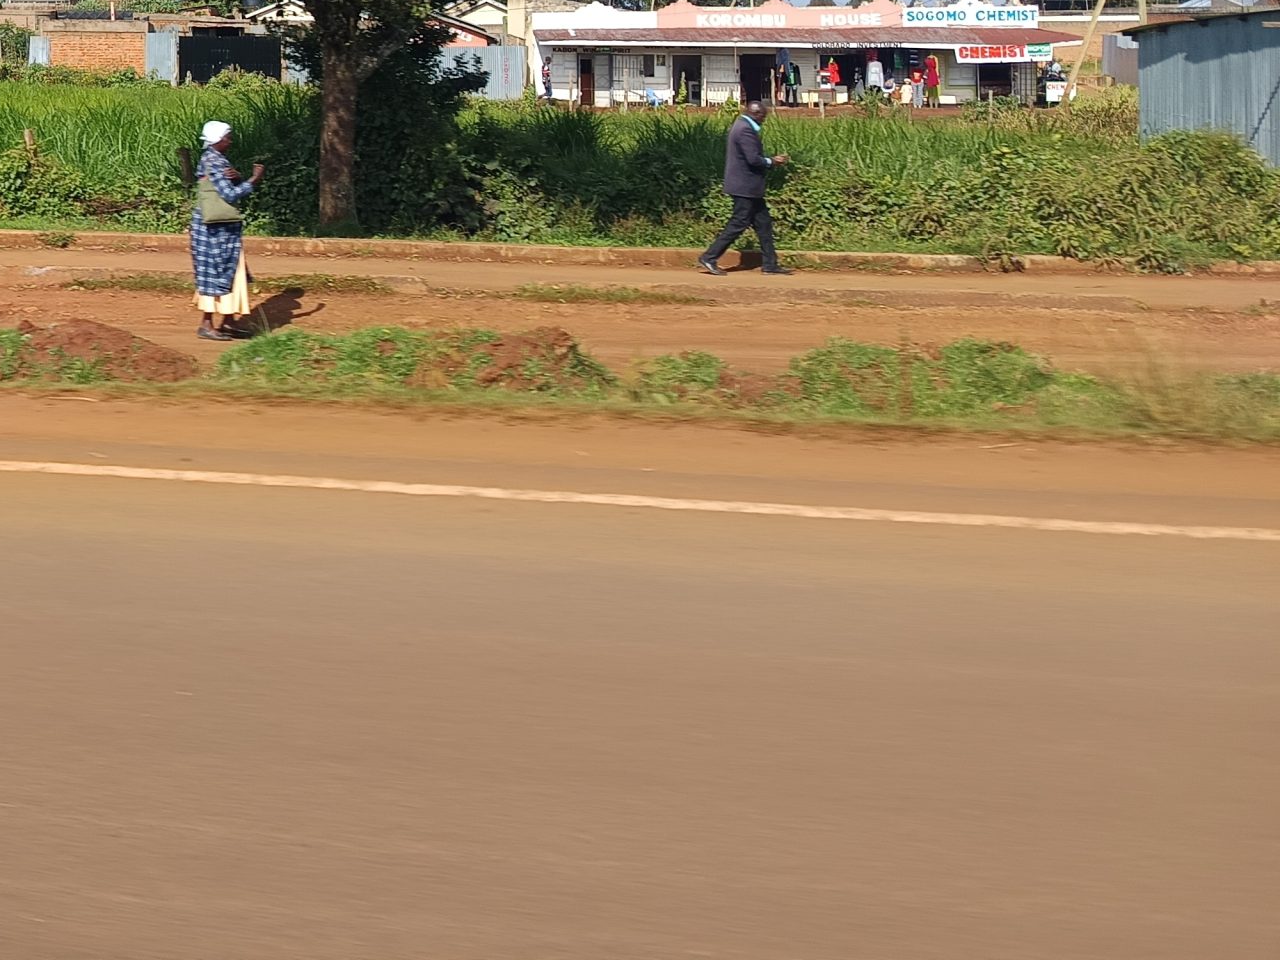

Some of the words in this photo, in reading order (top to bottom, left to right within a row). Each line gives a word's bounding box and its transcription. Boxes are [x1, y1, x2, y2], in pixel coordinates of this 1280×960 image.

[821, 12, 882, 27] HOUSE
[906, 10, 967, 22] SOGOMO
[975, 9, 1037, 21] CHEMIST
[959, 44, 1026, 59] CHEMIST
